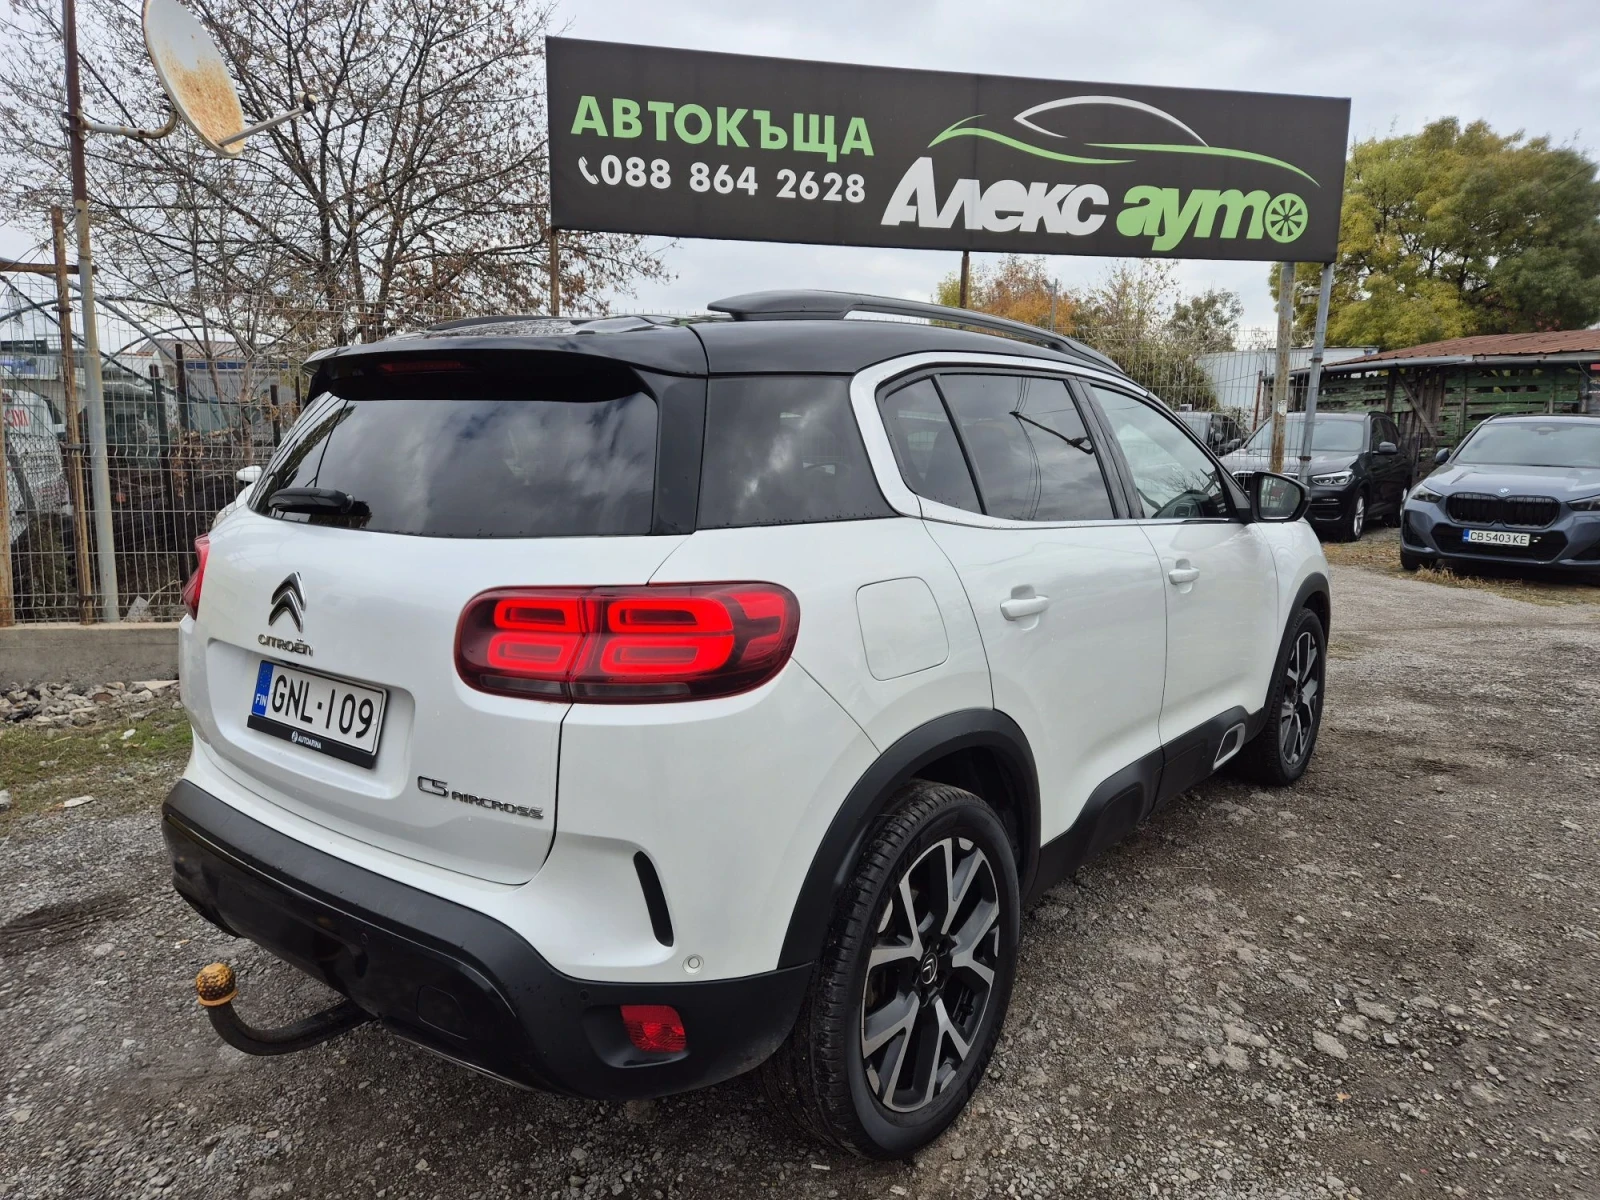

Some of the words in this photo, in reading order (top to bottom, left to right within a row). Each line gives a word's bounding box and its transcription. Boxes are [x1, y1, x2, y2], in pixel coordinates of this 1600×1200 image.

[570, 95, 874, 163] АВТОКЪЩА
[600, 154, 671, 189] 088
[689, 162, 758, 195] 864
[776, 168, 866, 202] 2628
[1470, 531, 1483, 541] CB
[1486, 533, 1511, 543] 5403
[1512, 534, 1527, 544] KE
[255, 693, 268, 707] FIN
[417, 775, 449, 798] C5
[451, 791, 544, 820] AIRCROSS
